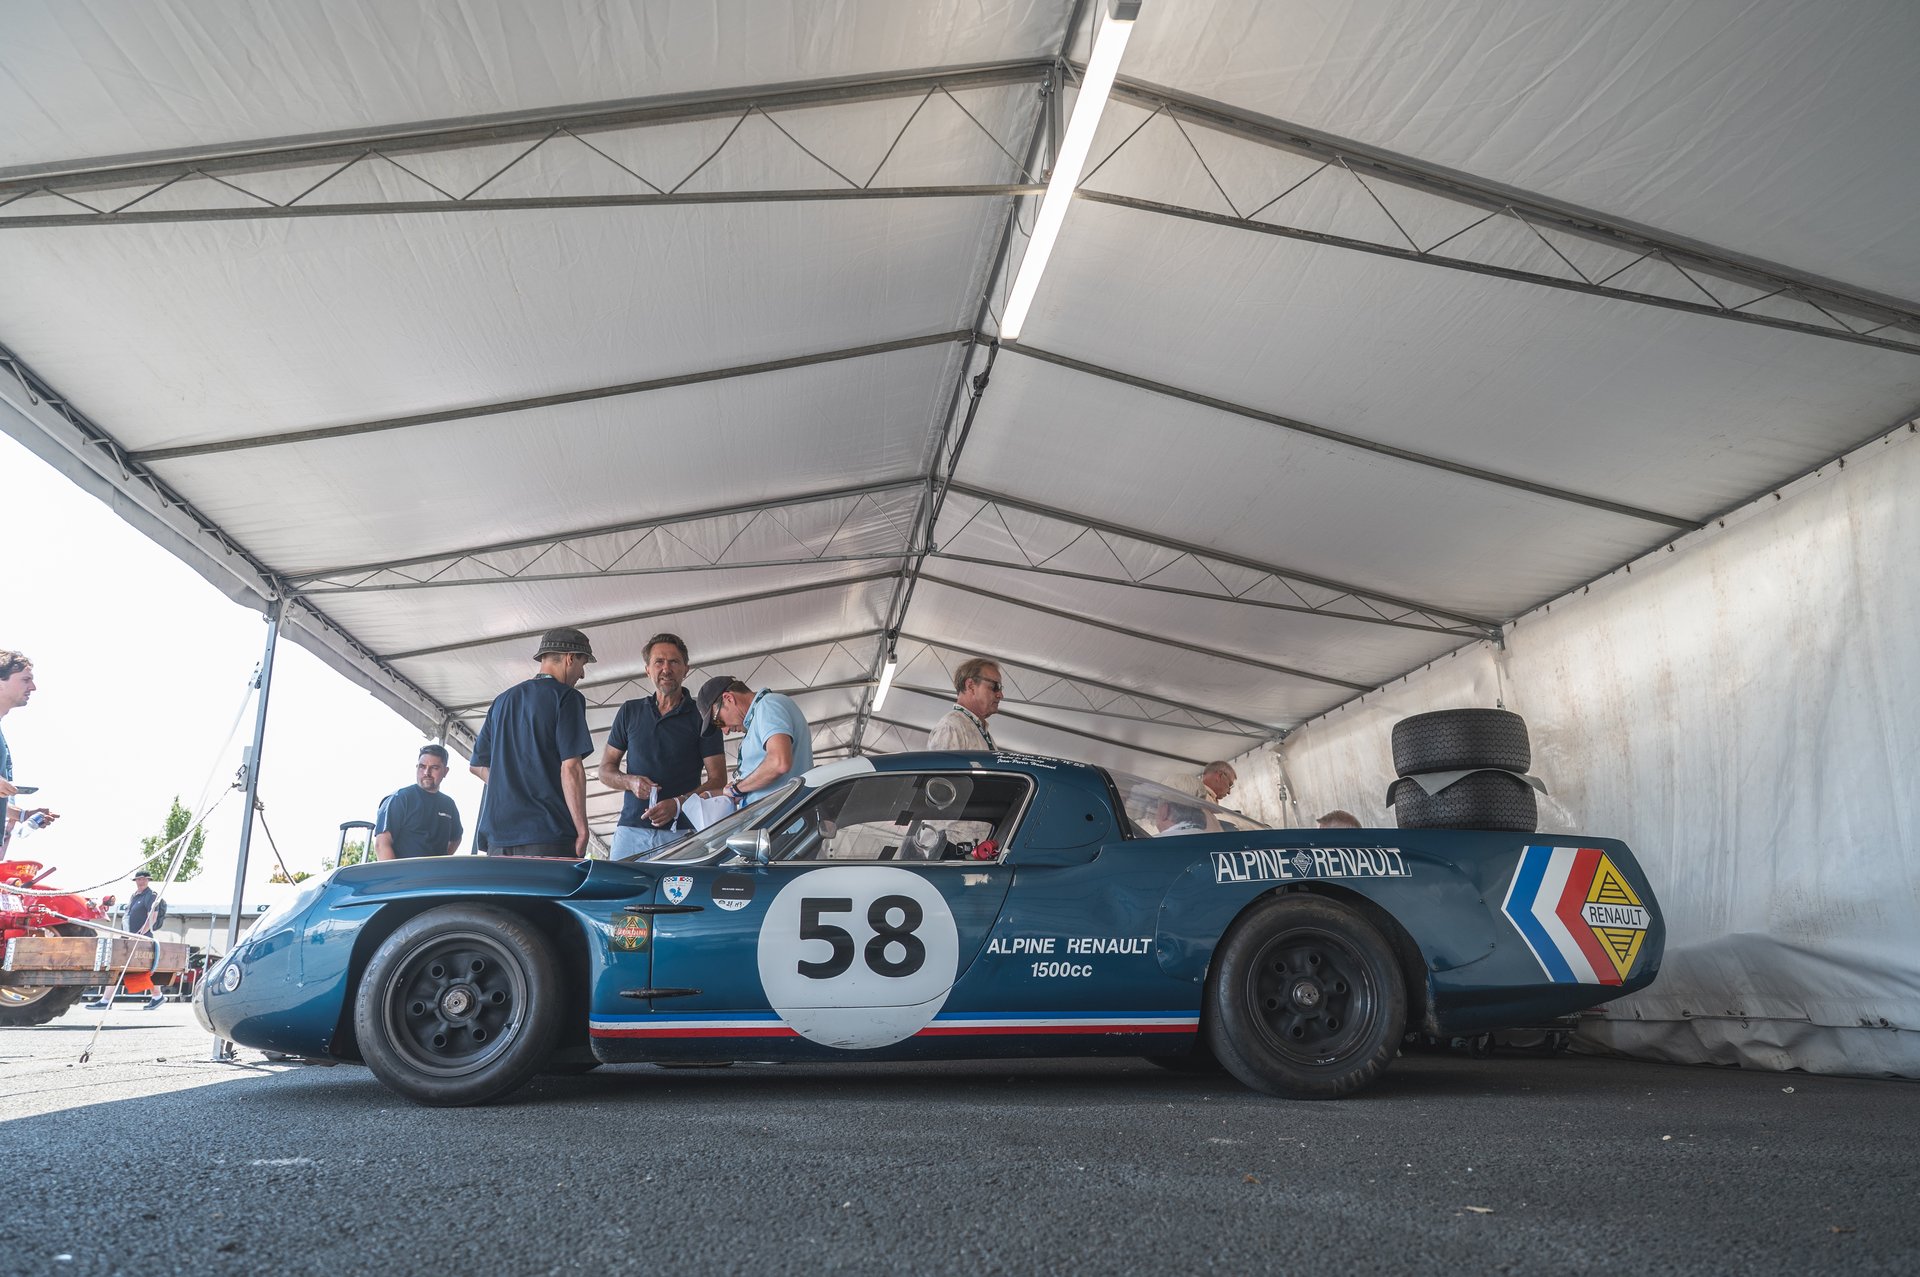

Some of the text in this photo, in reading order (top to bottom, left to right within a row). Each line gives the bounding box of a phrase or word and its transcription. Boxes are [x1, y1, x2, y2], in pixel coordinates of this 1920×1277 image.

[1217, 848, 1406, 882] ALPINE RENAULT
[1589, 906, 1642, 926] RENAULT
[797, 894, 926, 979] 58
[986, 938, 1153, 954] ALPINE RENAULT
[1030, 961, 1093, 978] 1500cc
